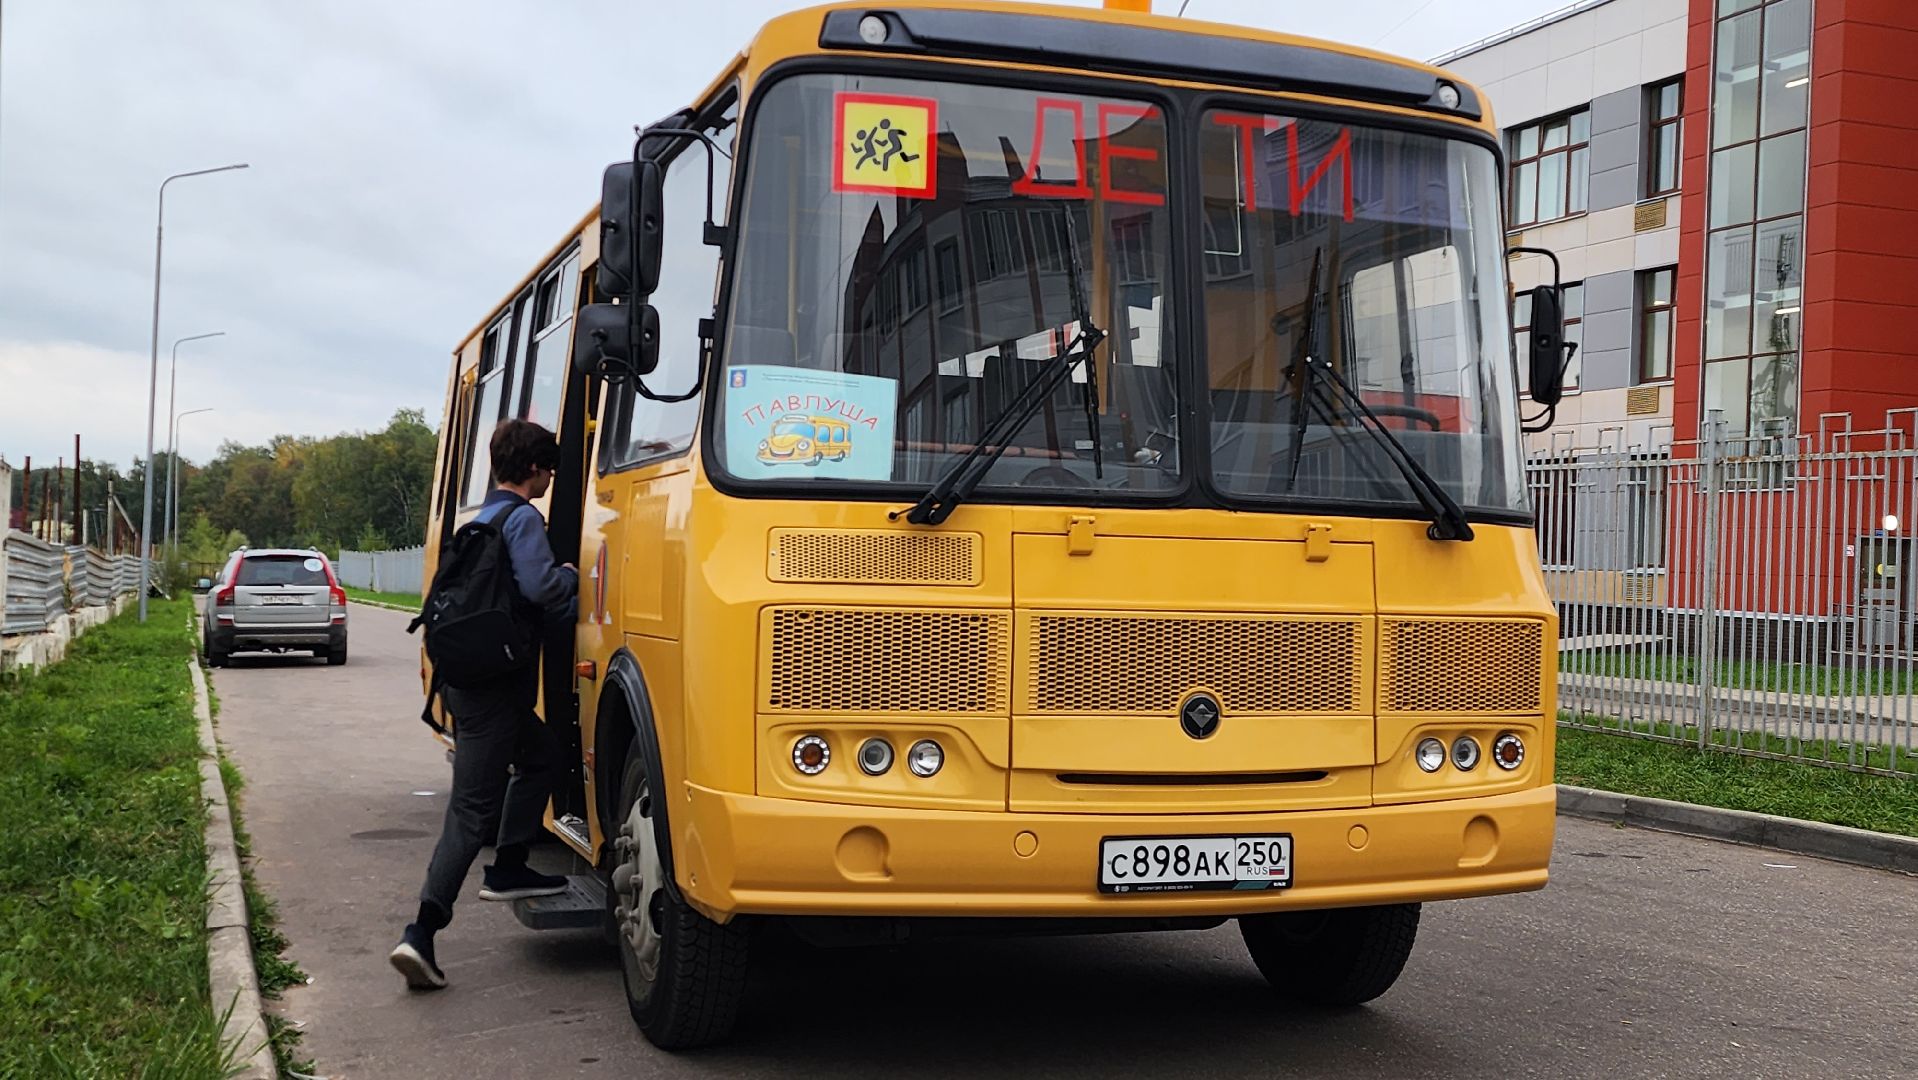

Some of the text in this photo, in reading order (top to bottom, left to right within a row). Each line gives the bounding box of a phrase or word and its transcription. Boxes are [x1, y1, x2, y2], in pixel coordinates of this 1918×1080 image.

[1011, 96, 1355, 223] ДЕТИ
[742, 395, 878, 430] ПАВЛУША
[1237, 841, 1282, 867] 250
[1246, 866, 1268, 875] RUS
